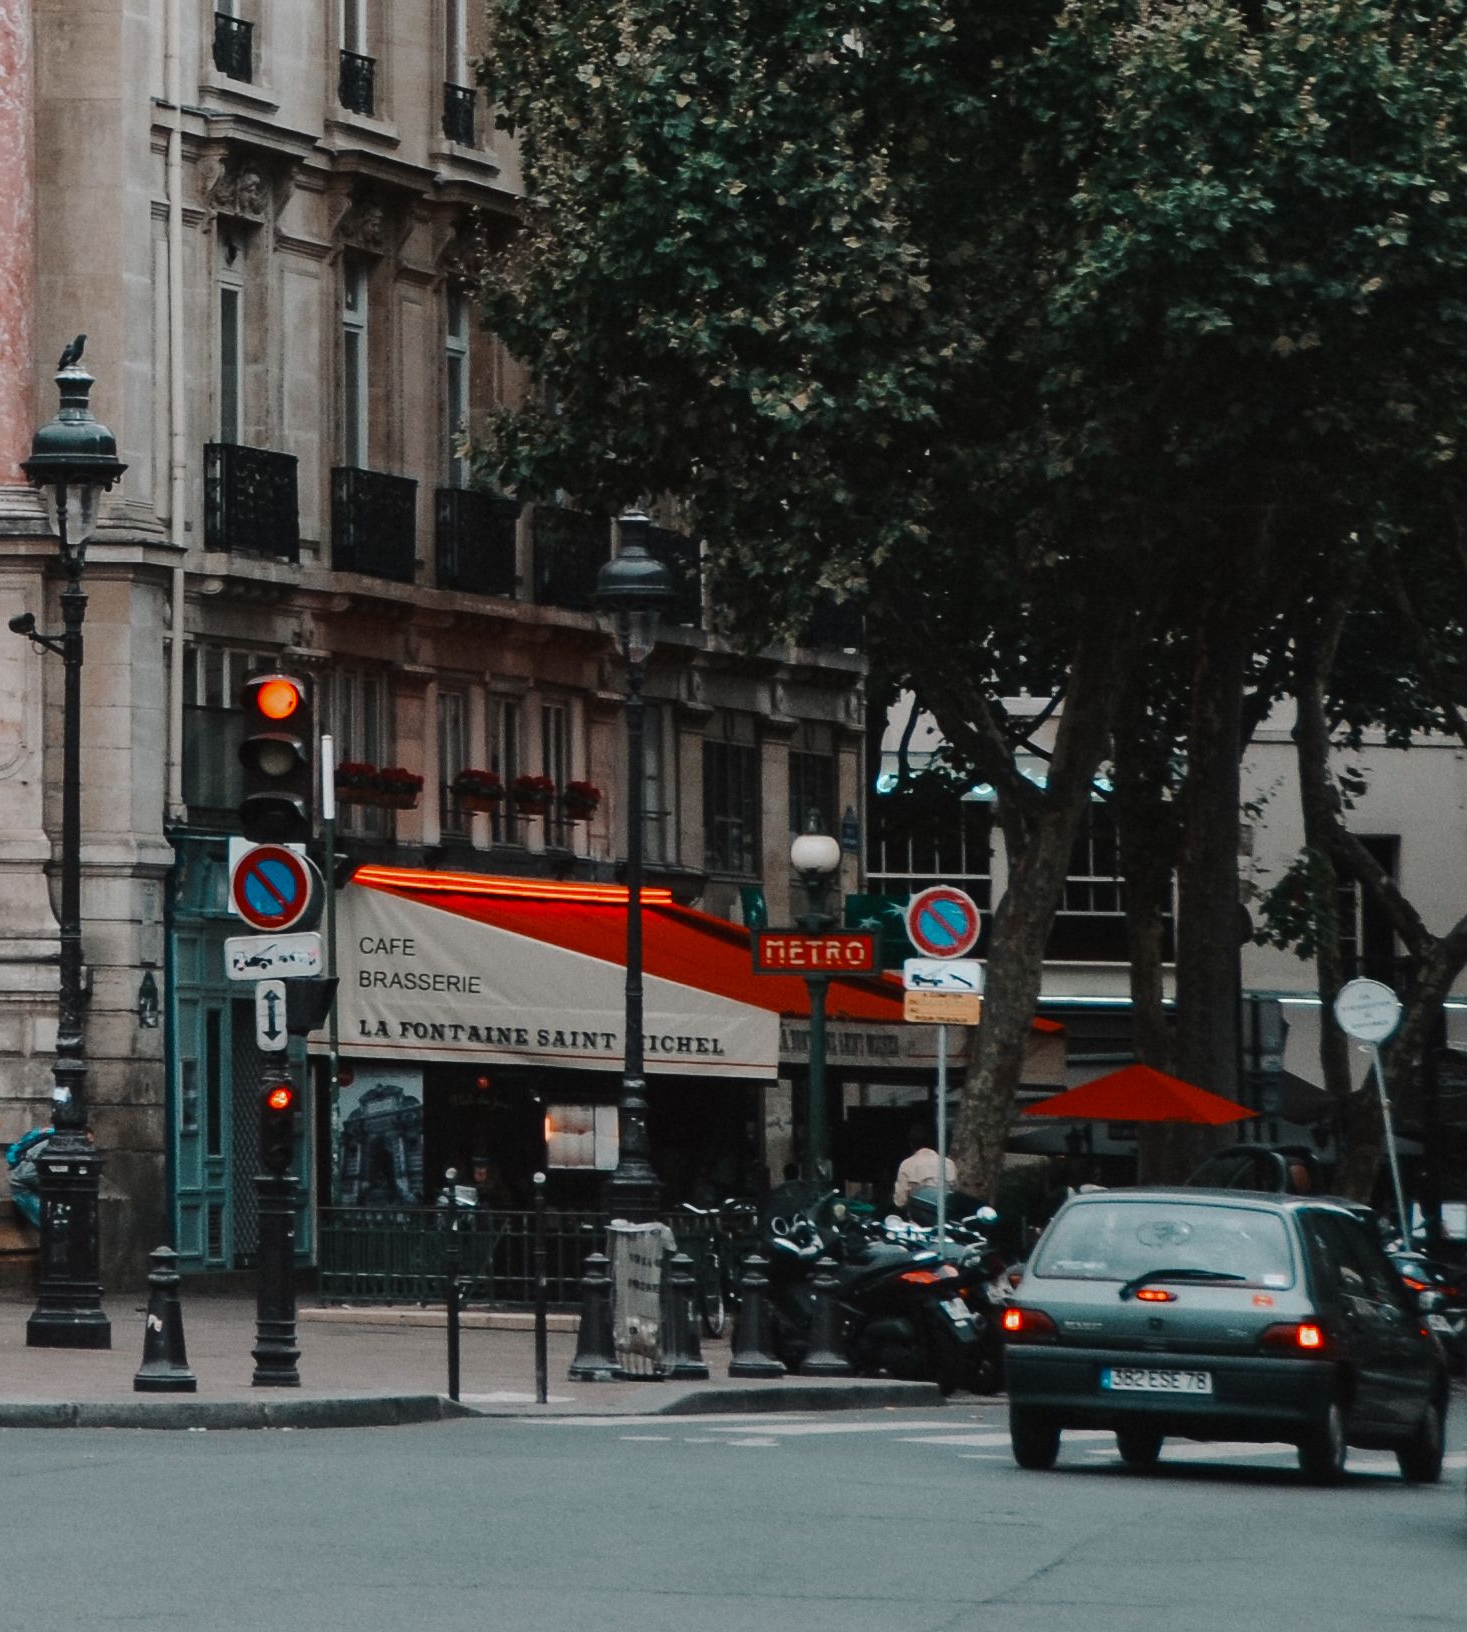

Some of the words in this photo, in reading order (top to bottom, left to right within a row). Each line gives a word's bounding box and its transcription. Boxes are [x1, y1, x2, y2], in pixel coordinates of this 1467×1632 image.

[359, 936, 416, 957] CAFE
[765, 940, 866, 966] METRO
[358, 970, 482, 994] BRASSERIE
[359, 1019, 391, 1039] LA
[399, 1020, 530, 1046] FONTAINE
[536, 1029, 617, 1050] SAINT
[641, 1033, 726, 1057] ICHEL
[1148, 1370, 1181, 1389] ESE
